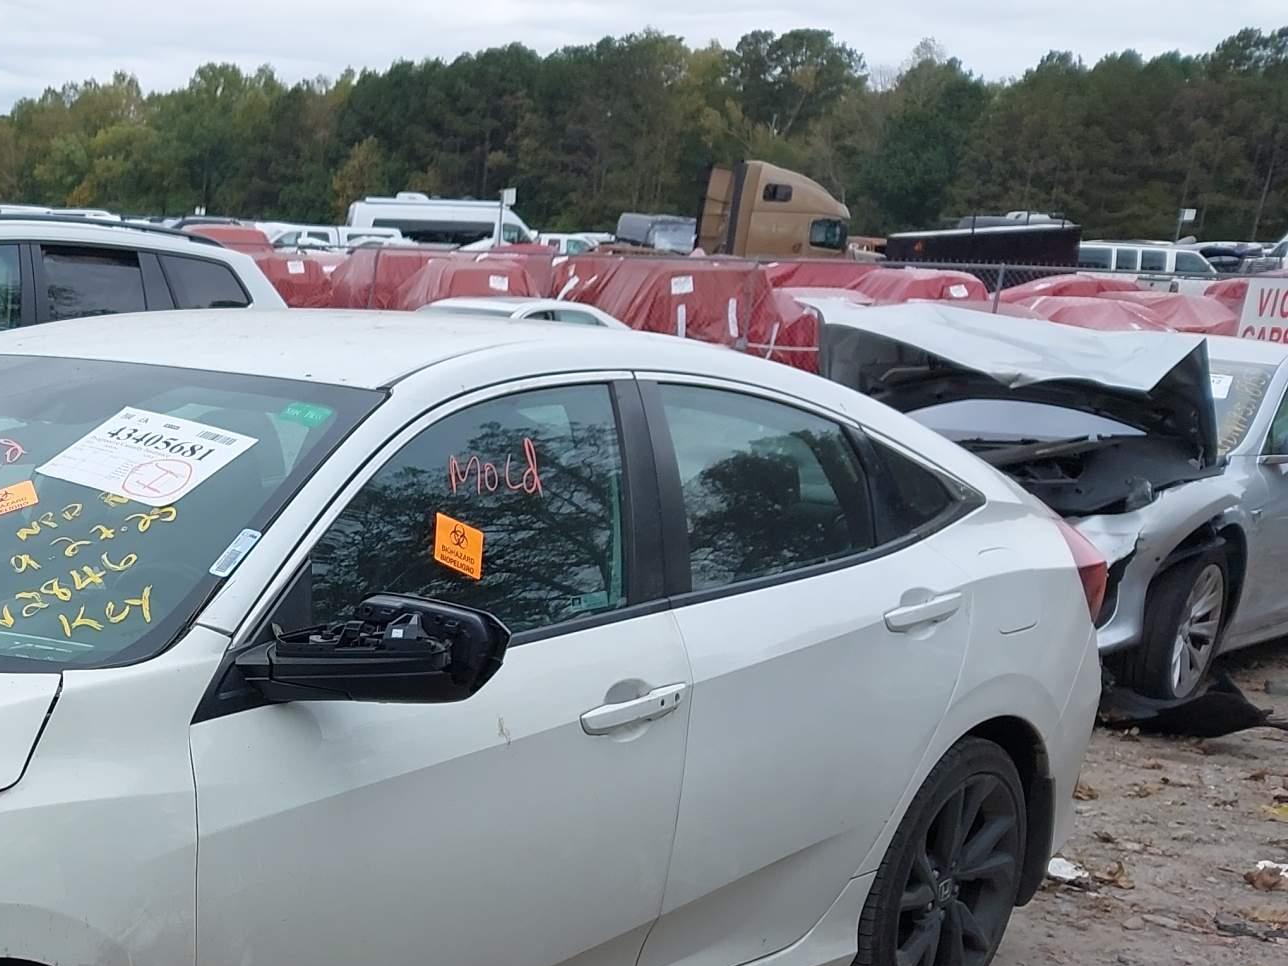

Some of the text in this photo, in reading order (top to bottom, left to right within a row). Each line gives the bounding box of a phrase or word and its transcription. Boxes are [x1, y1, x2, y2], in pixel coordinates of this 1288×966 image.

[107, 425, 216, 463] 43405681
[440, 553, 475, 575] BIOPELIGRO
[441, 544, 475, 565] BIOHAZARD
